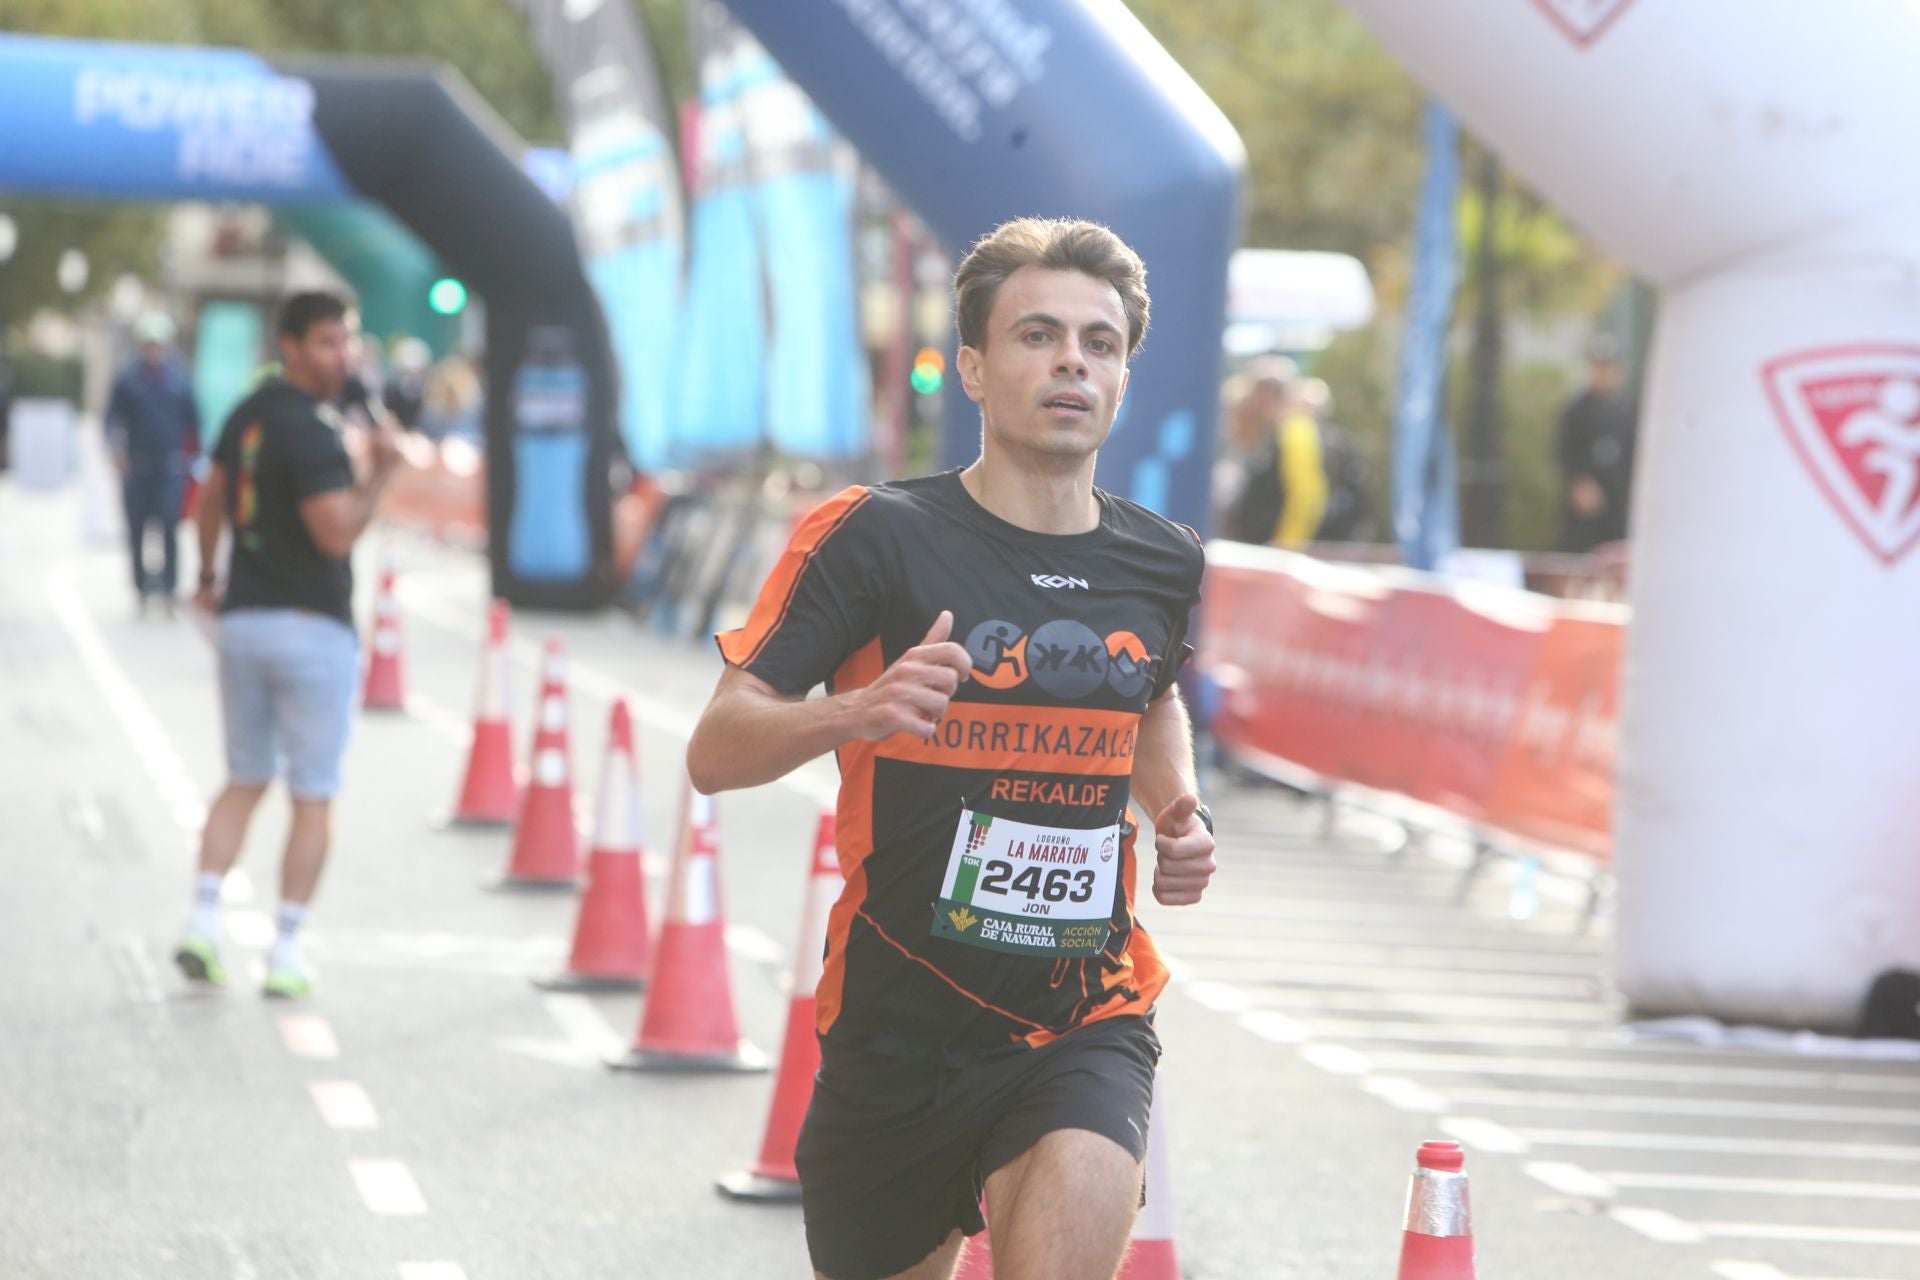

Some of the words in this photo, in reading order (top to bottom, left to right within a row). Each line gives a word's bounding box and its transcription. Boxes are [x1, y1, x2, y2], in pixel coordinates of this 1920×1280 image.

[991, 778, 1109, 806] REKALDE
[1036, 834, 1071, 845] LOGROÑO
[1007, 839, 1025, 859] LA
[1028, 843, 1089, 865] MARATÓN
[963, 856, 981, 867] 10K
[981, 860, 1096, 903] 2463
[1022, 903, 1050, 915] JON
[983, 918, 1013, 932] CAJA
[1015, 923, 1054, 936] RURAL
[1063, 926, 1101, 936] ACCIÓN
[980, 928, 998, 940] DE
[1001, 933, 1056, 948] NAVARRA
[1060, 938, 1097, 948] SOCIAL
